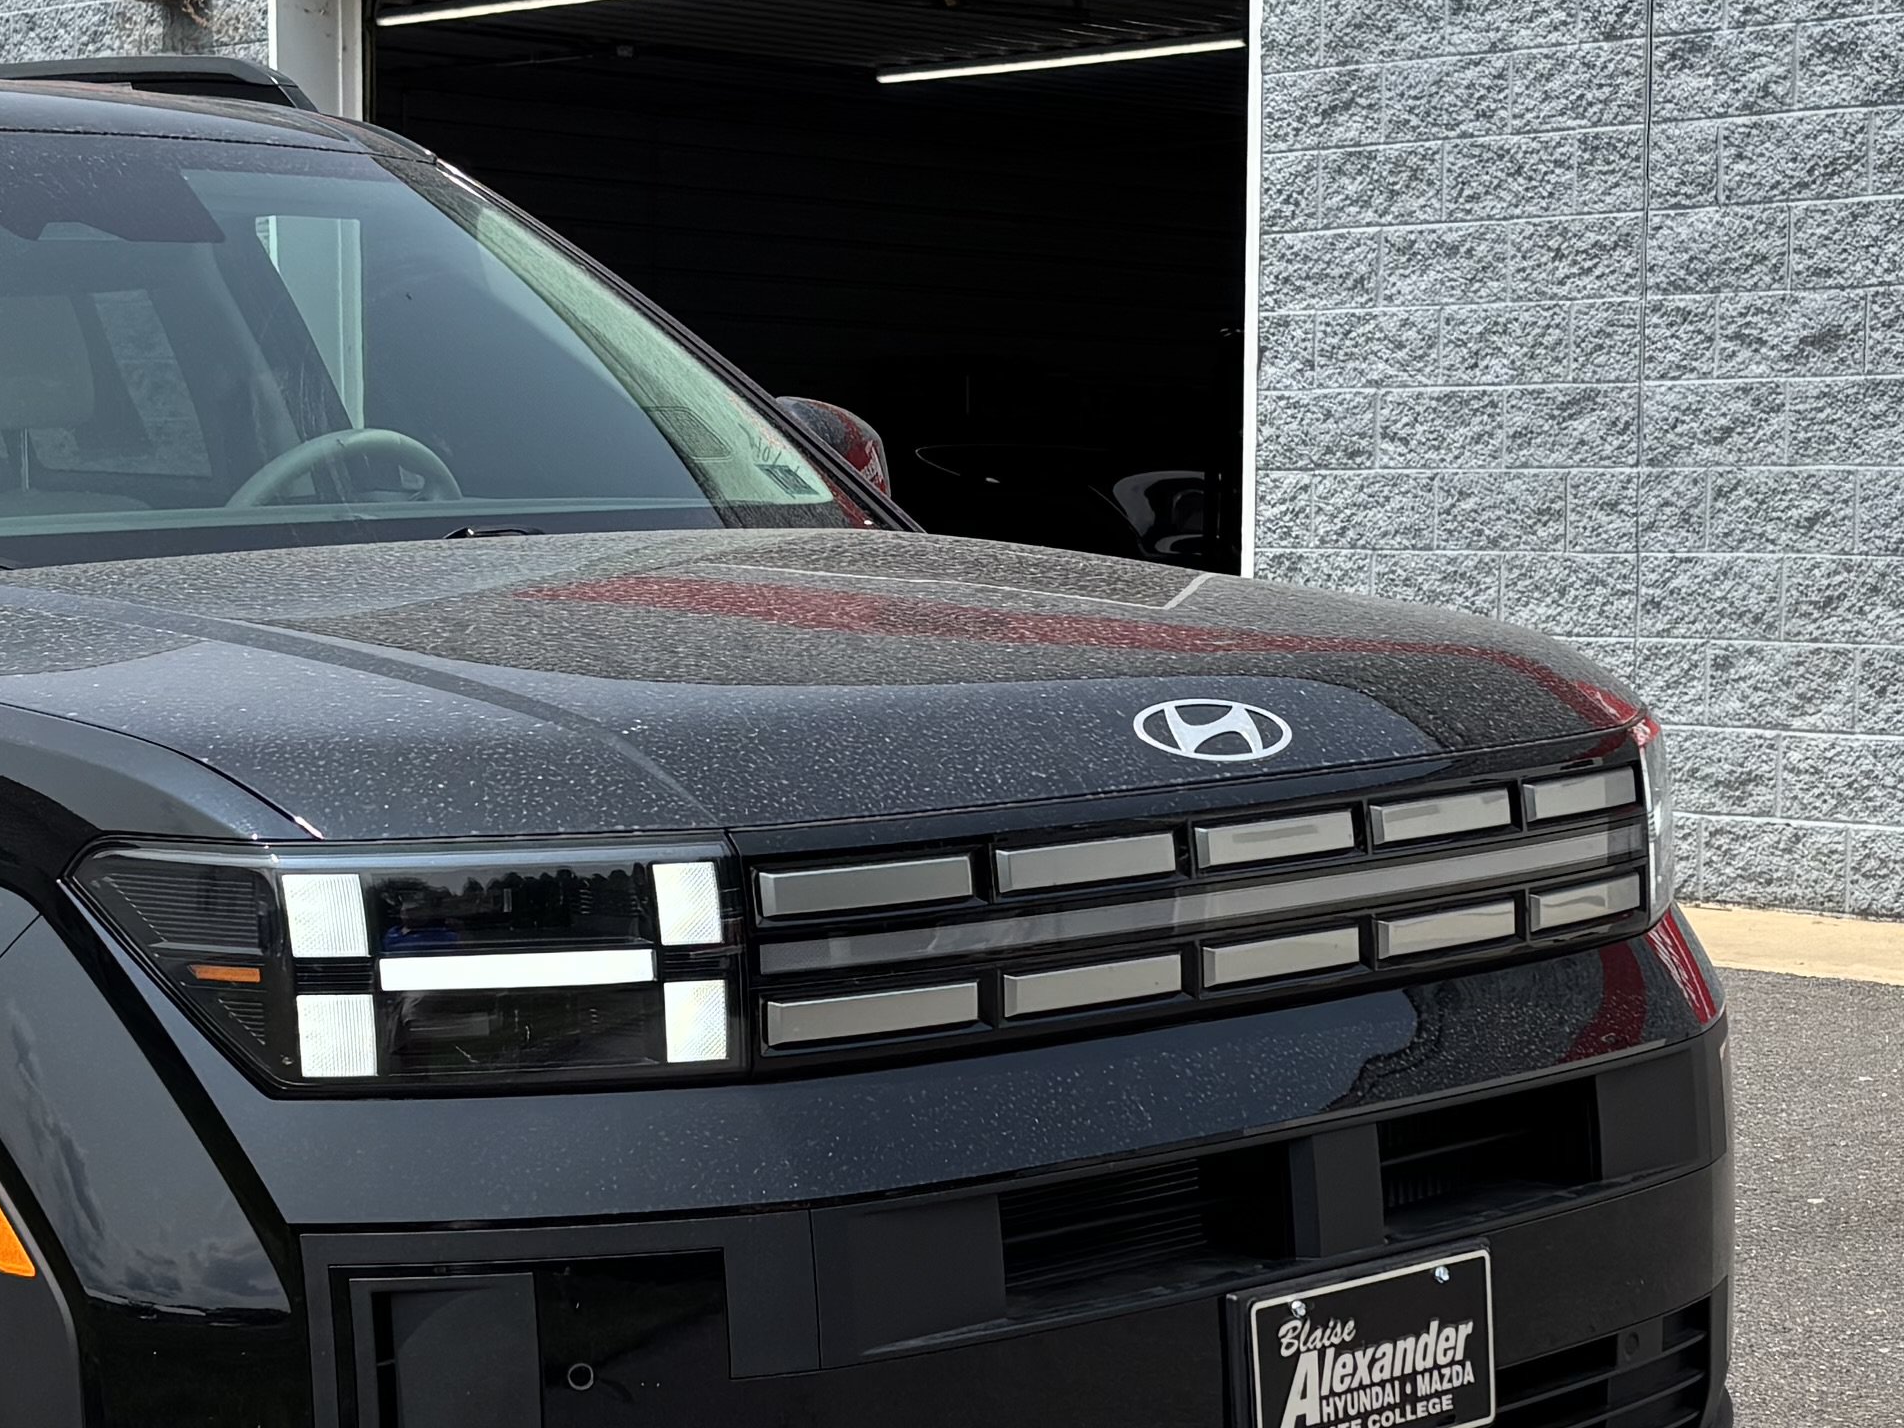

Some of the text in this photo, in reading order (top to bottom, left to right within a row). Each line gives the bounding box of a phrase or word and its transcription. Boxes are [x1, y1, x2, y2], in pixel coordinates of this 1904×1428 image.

[1278, 1317, 1357, 1358] Blaise
[1320, 1359, 1476, 1423] HYUNDAI MAZDA
